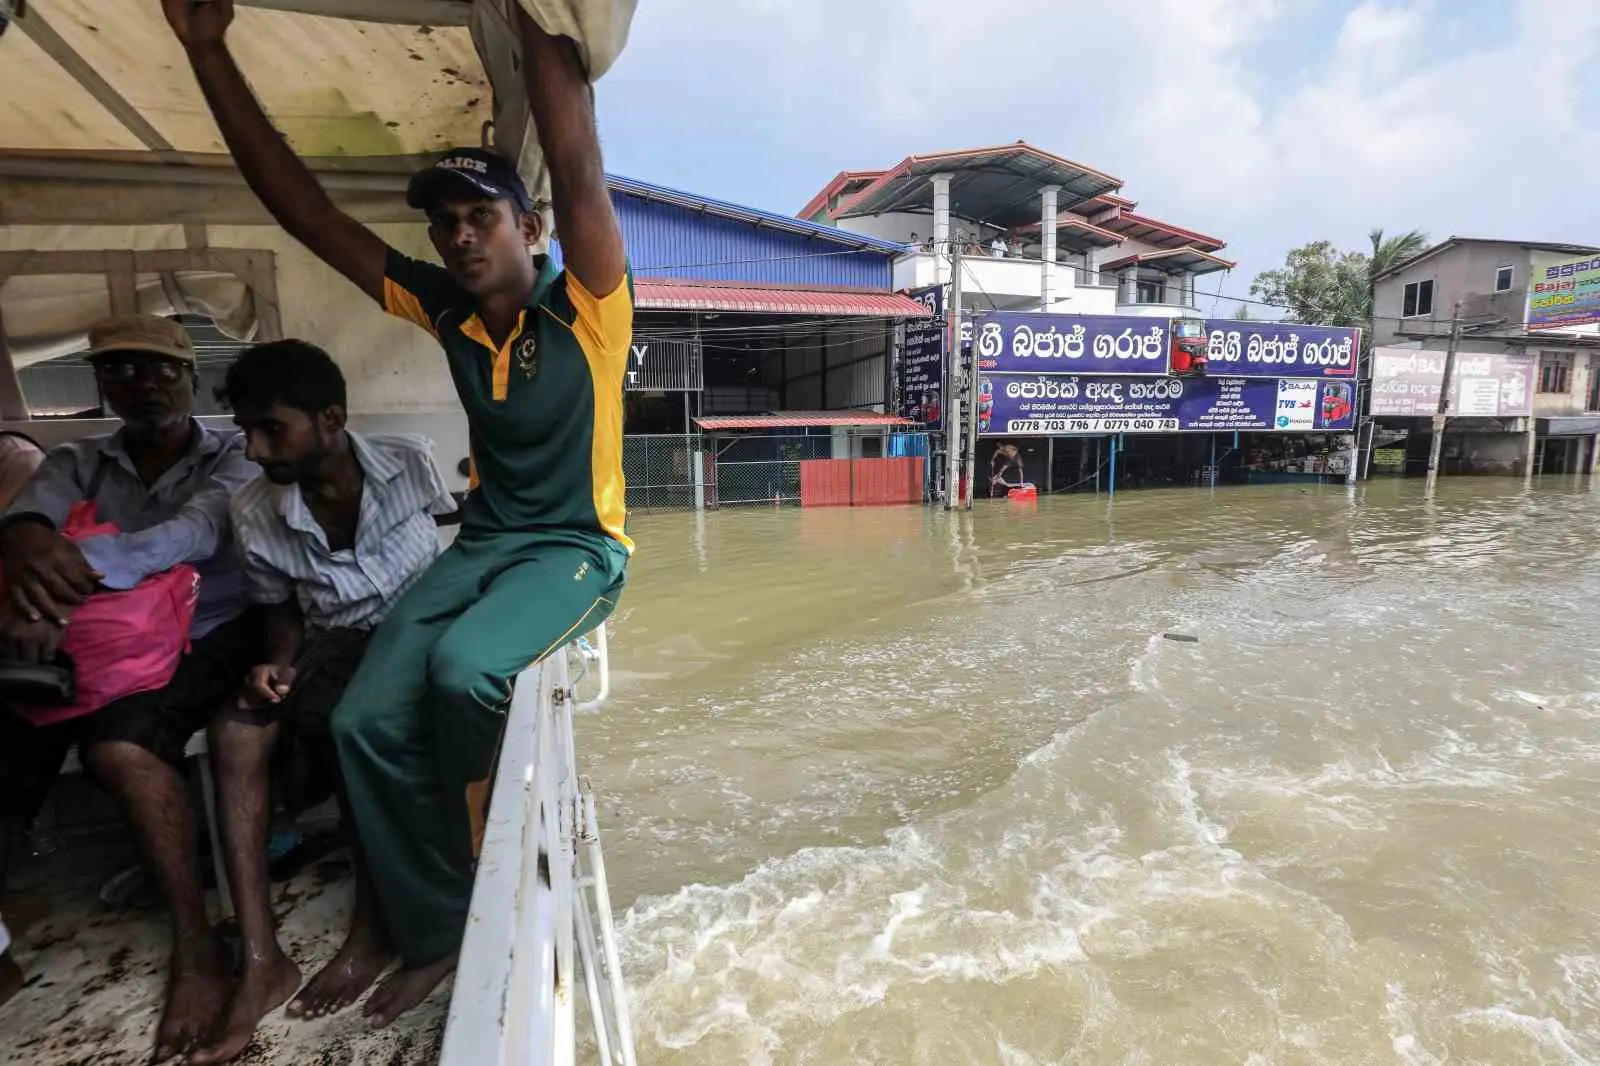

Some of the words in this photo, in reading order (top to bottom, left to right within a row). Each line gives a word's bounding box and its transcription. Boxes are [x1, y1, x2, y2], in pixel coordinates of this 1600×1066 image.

[435, 156, 488, 174] LICE
[1093, 326, 1163, 360] ගරාජ්
[1303, 337, 1352, 366] ගරාජ්
[1278, 399, 1296, 409] TVS
[1011, 420, 1040, 431] 0778
[1044, 420, 1065, 431] 703
[1069, 420, 1089, 431] 796
[1104, 420, 1129, 430] 0779
[1133, 420, 1154, 430] 040
[1158, 420, 1176, 429] 743
